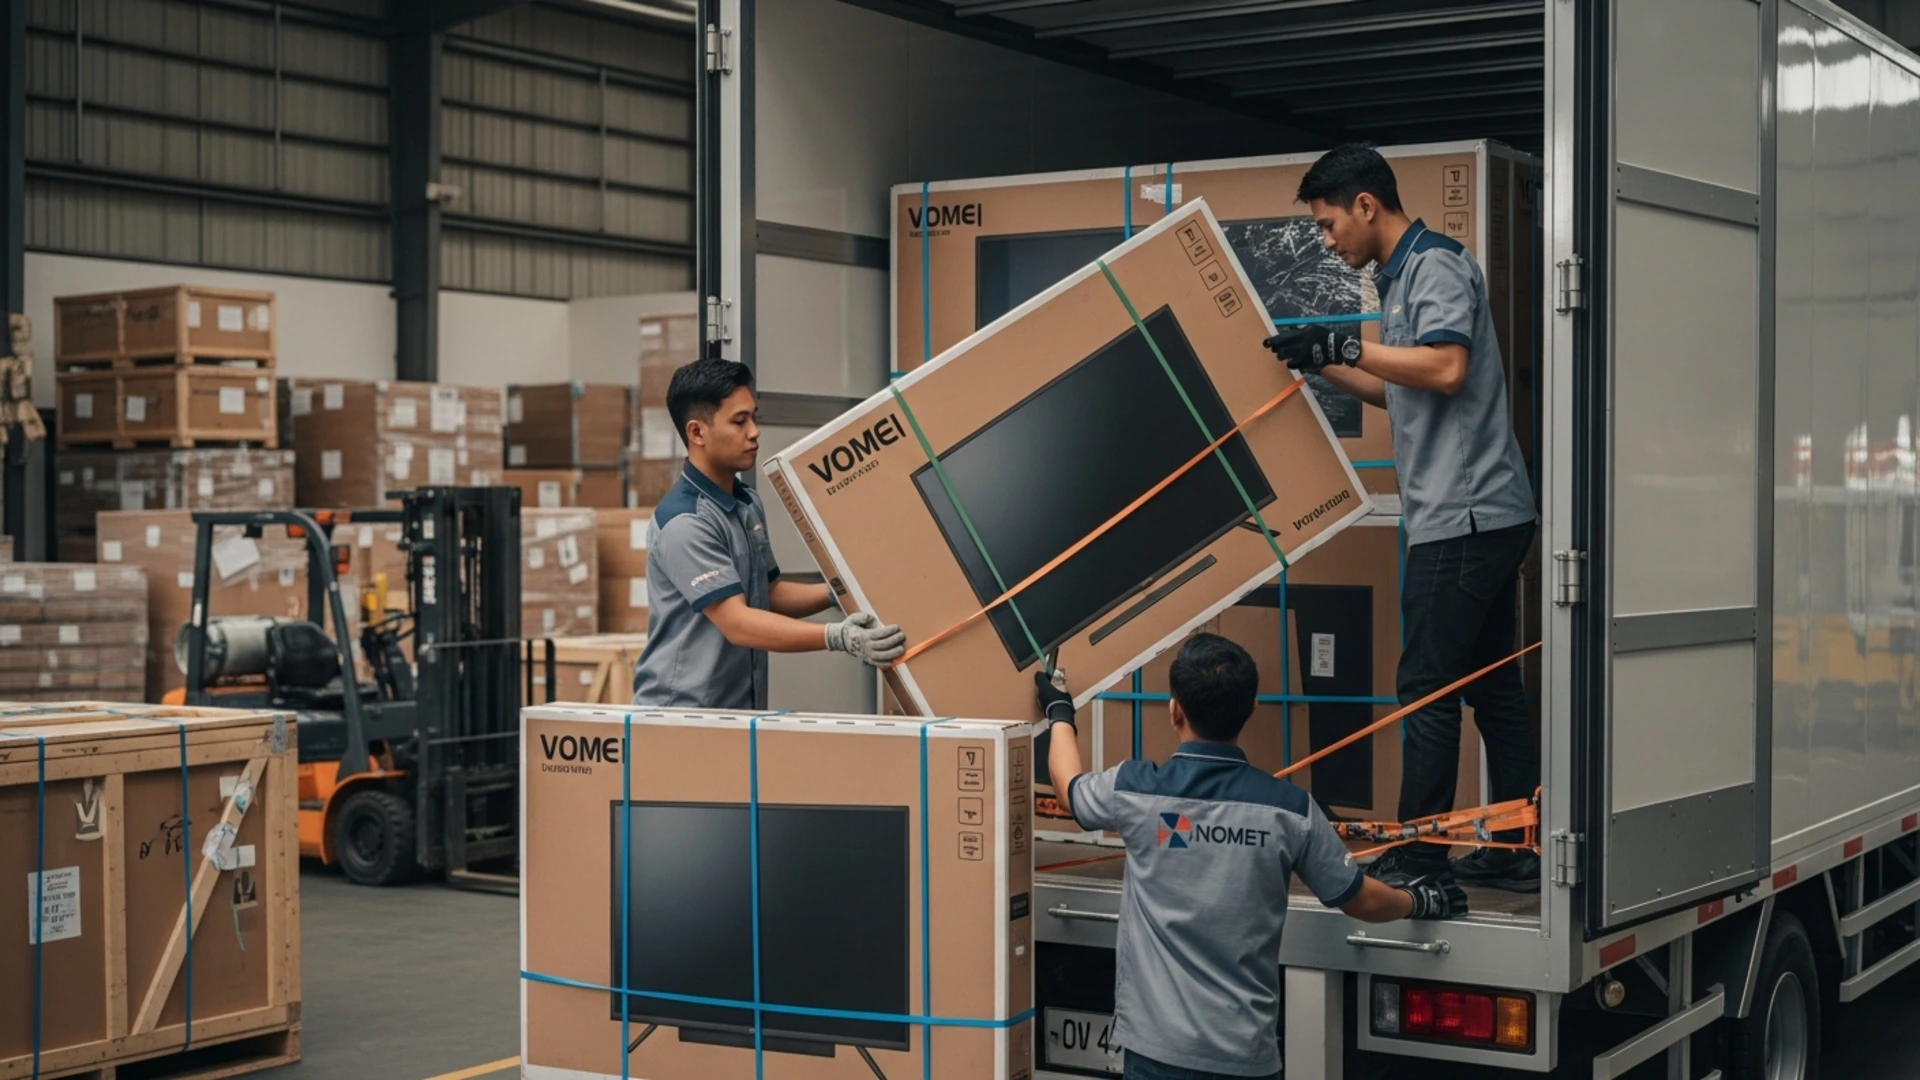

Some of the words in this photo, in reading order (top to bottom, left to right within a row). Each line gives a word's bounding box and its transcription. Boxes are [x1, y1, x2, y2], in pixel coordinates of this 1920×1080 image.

[908, 203, 982, 228] VOMEI
[808, 413, 906, 483] VOMEI
[540, 734, 626, 764] VOMEI
[1196, 824, 1270, 848] NOMET
